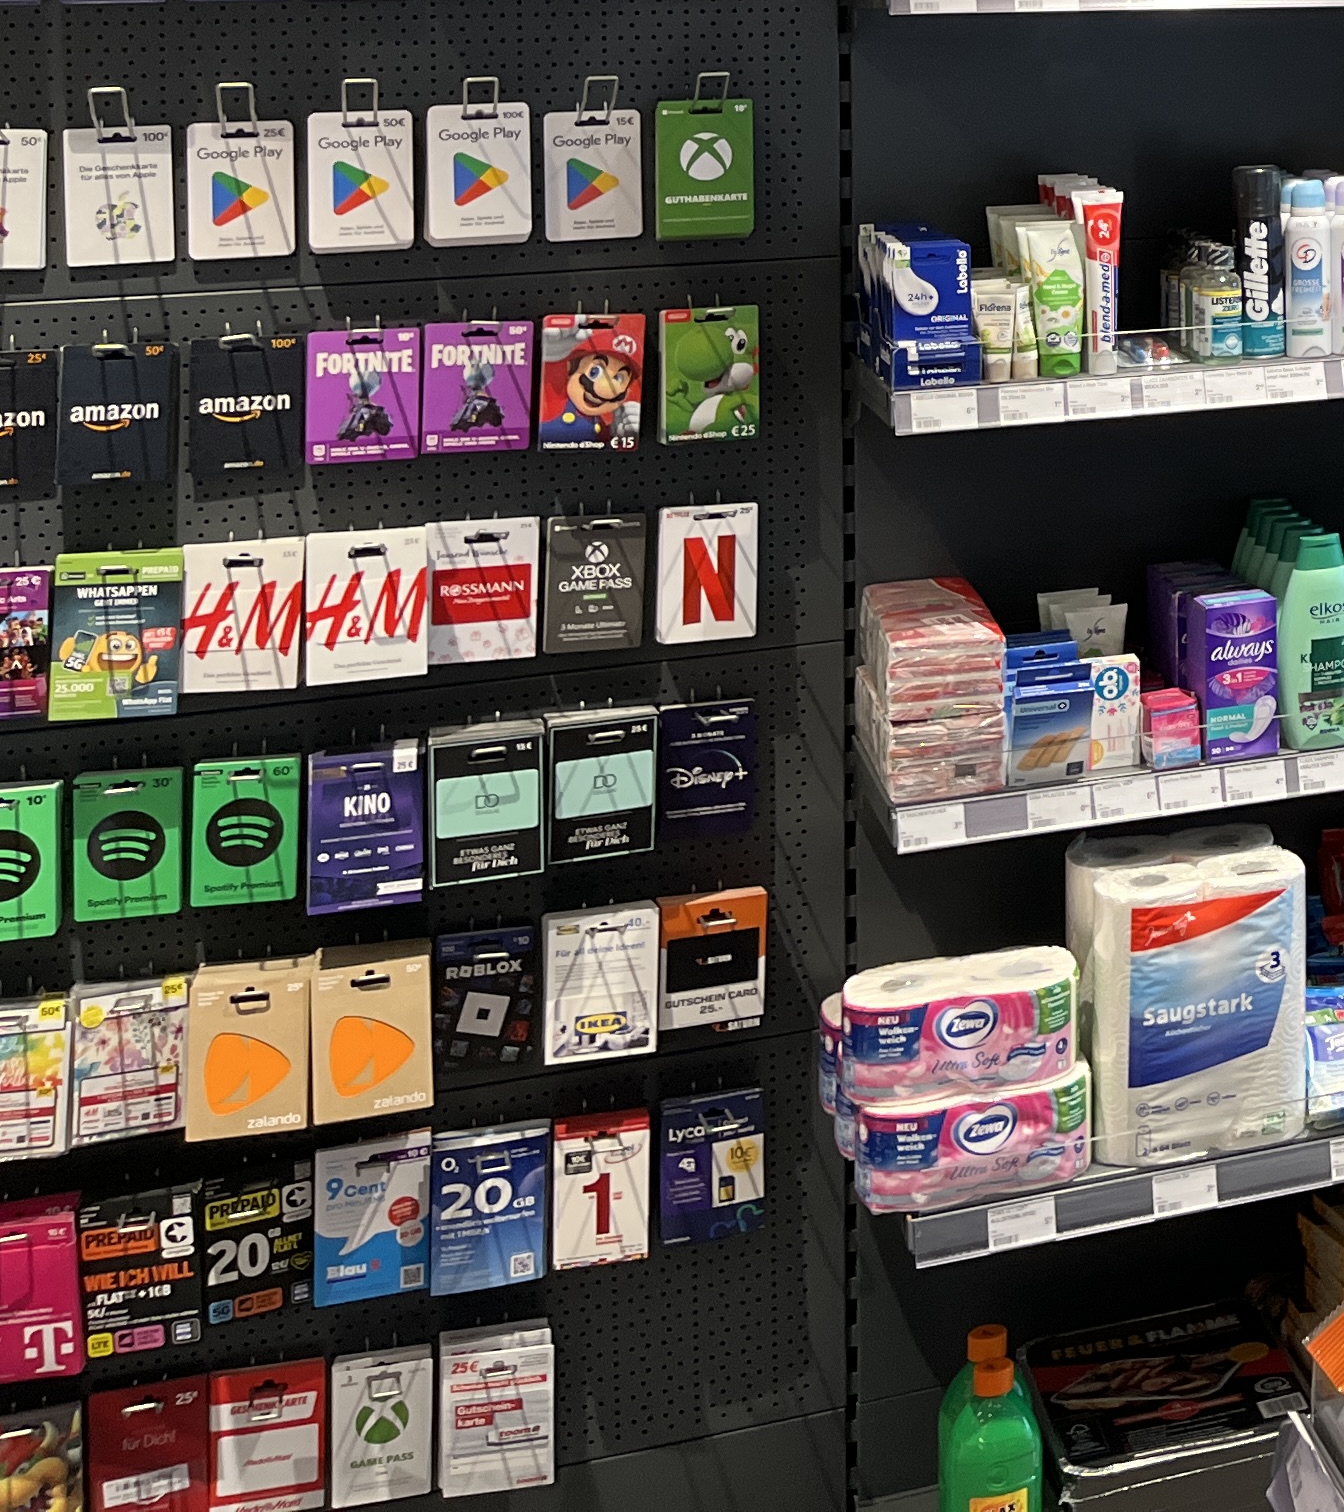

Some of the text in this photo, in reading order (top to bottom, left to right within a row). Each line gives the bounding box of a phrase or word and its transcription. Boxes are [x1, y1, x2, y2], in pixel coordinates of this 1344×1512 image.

[318, 134, 403, 151] Google Play
[439, 127, 521, 142] Google Play
[552, 133, 631, 149] Google Play
[197, 146, 283, 162] Google Play
[665, 193, 748, 205] GUTHABENKARTE
[958, 250, 967, 294] Labello
[1245, 221, 1269, 321] Gillette
[1101, 261, 1111, 343] blend-a-med
[316, 349, 415, 377] FORTNITE
[431, 342, 528, 368] FORTNITE
[921, 376, 955, 386] Labello
[70, 402, 159, 424] amazon
[199, 394, 291, 415] amazon
[572, 564, 621, 579] XBOX
[683, 535, 735, 625] N
[77, 585, 157, 598] WHATSAPPEN
[440, 579, 524, 598] ROSSMANN
[559, 577, 632, 592] GAME PASS
[306, 566, 426, 651] H&M
[181, 579, 303, 660] H&M
[1211, 640, 1274, 660] always
[1020, 702, 1056, 713] Universal
[1210, 713, 1246, 723] NORMAL
[344, 793, 390, 816] KINO
[1270, 952, 1280, 966] 3
[446, 959, 522, 979] ROBLOX
[665, 988, 758, 1009] GUTSCHEIN CARD
[1143, 994, 1253, 1026] Saugstark
[579, 1015, 626, 1030] IKEA
[878, 1016, 899, 1024] NEU
[951, 1014, 985, 1033] Zewa
[879, 1026, 918, 1036] Wolken-
[879, 1034, 906, 1046] weich
[374, 1090, 426, 1109] zalando
[247, 1113, 301, 1128] zalando
[969, 1120, 1004, 1138] Zewa
[669, 1126, 706, 1143] Lyca
[326, 1178, 386, 1200] 9 Cent
[440, 1178, 513, 1221] 20
[208, 1234, 269, 1286] 20
[326, 1263, 366, 1280] Blau
[1052, 1314, 1239, 1360] FEUER FLAMME
[457, 1403, 516, 1416] Gutschein-
